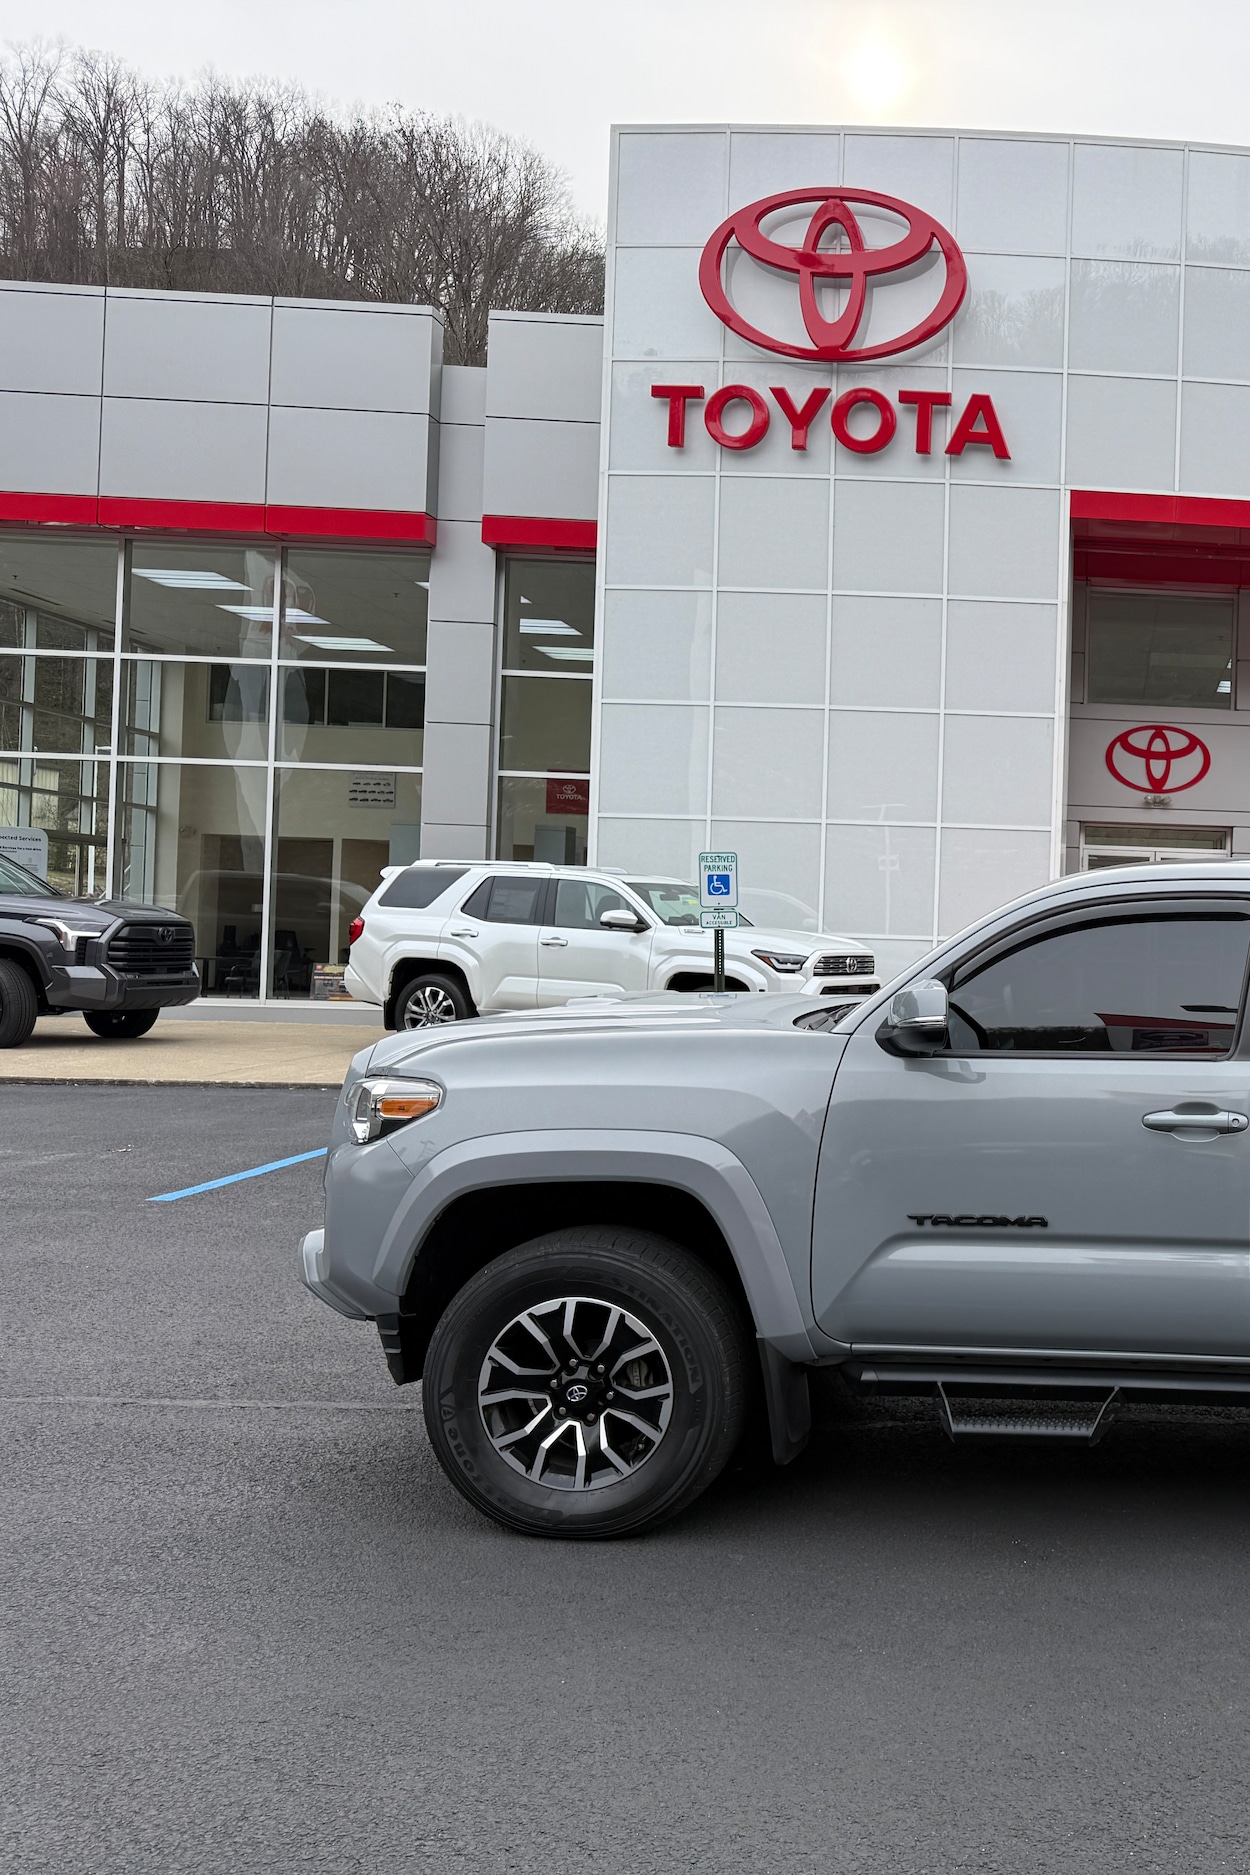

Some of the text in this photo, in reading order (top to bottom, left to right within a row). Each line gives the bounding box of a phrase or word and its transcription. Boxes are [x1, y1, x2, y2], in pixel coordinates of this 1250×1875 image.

[651, 384, 1012, 461] TOYOTA
[700, 855, 736, 863] RESERVED
[704, 864, 733, 872] PARKING
[907, 1213, 1049, 1228] TACOMA
